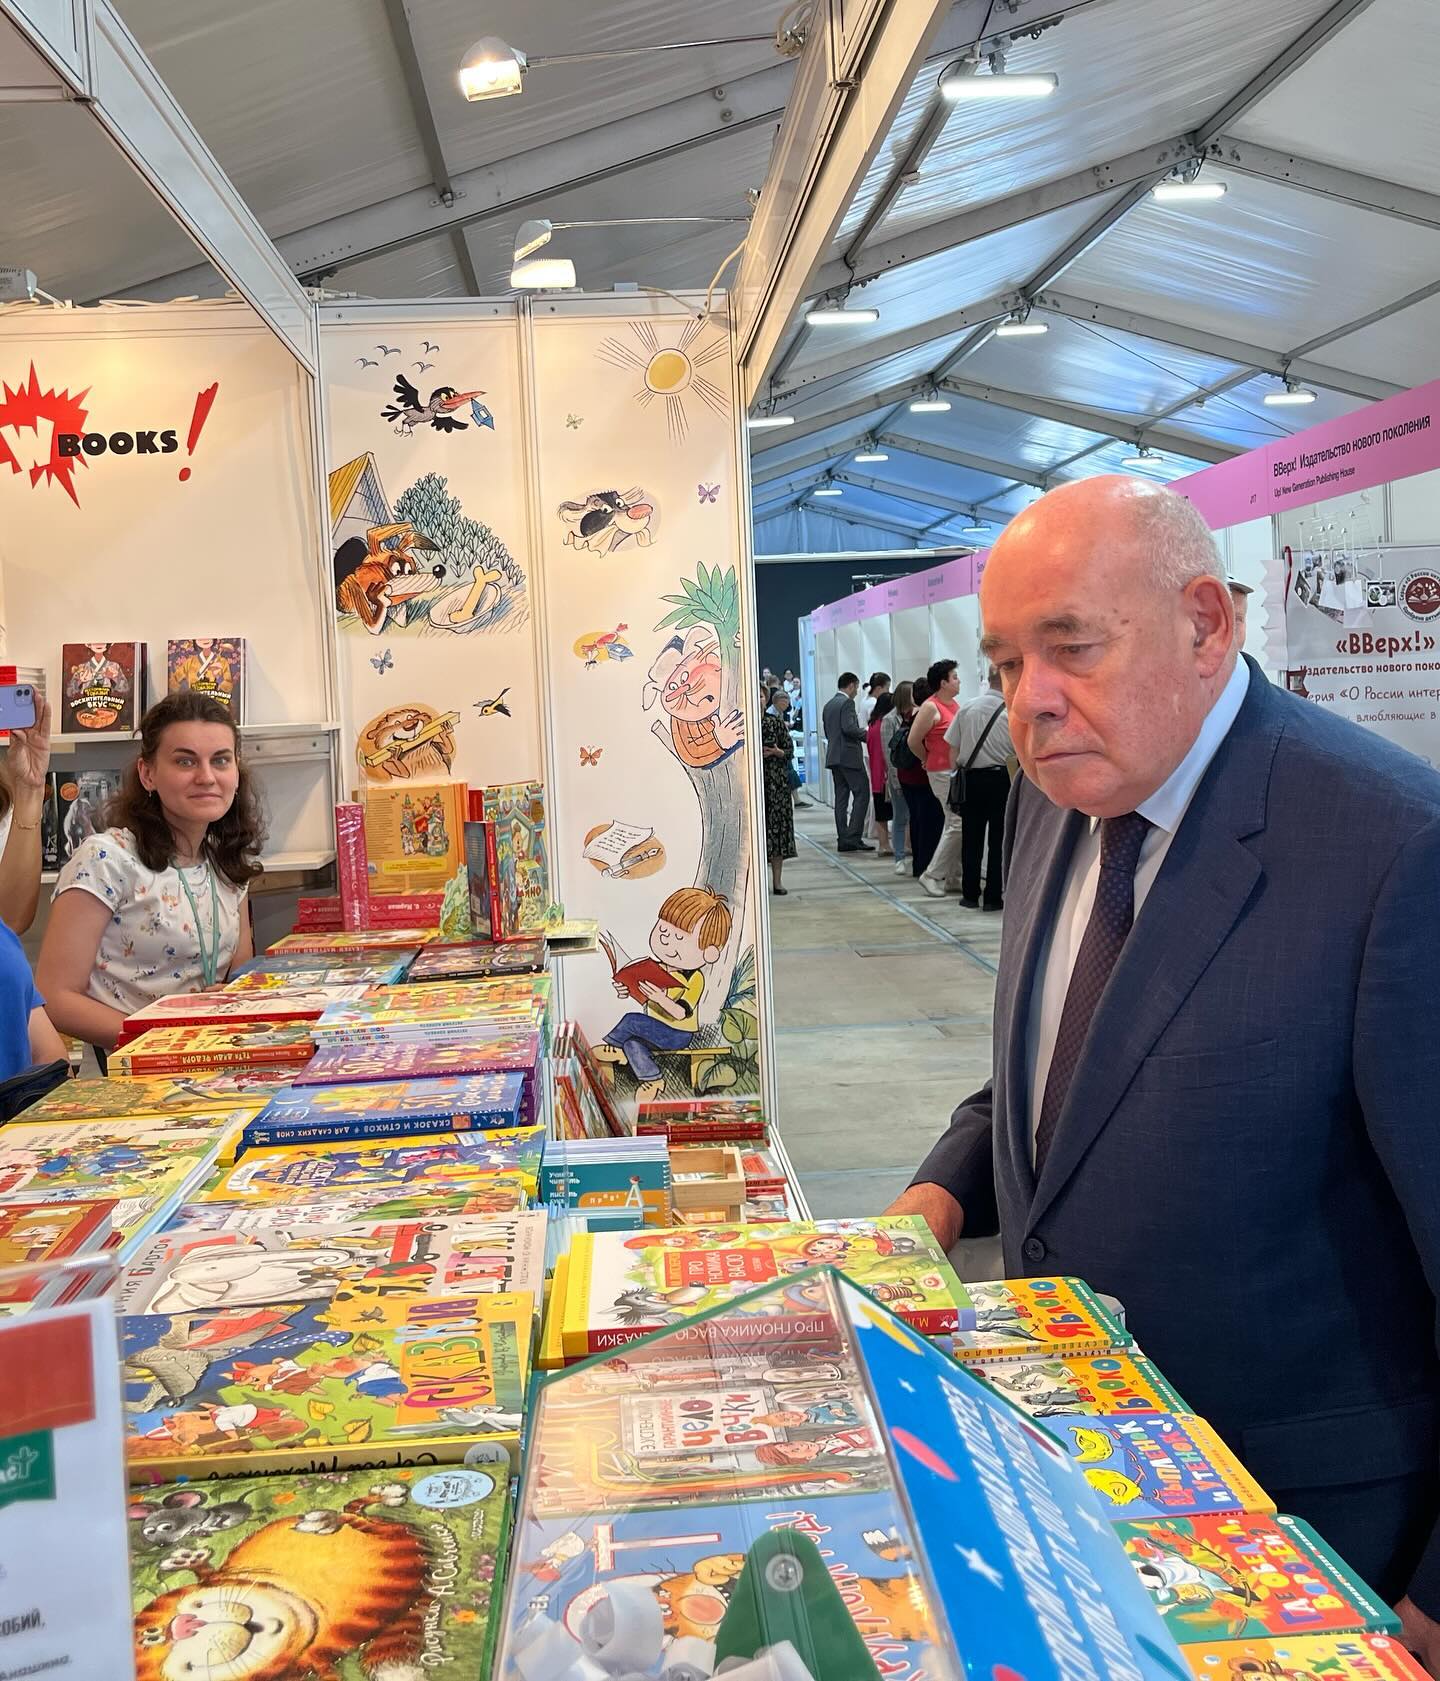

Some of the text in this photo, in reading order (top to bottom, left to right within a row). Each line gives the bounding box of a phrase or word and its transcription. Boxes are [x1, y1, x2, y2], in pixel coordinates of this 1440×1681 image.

[58, 430, 178, 457] BOOKS
[1273, 415, 1431, 477] ВВерх! Издательство нового поколения
[1274, 466, 1356, 498] Up! New Generation Publishing House
[1336, 630, 1435, 658] «ВВерх!»
[1376, 662, 1412, 673] нового
[70, 695, 125, 708] ВОСХИТИТЕЛЬНЫЙ
[1308, 691, 1335, 705] ерия
[1340, 686, 1360, 701] «О
[1365, 685, 1404, 700] России
[298, 1128, 332, 1137] СЛАДКИХ
[334, 1126, 350, 1135] ДЛЯ
[363, 1122, 401, 1133] СТИХОВ
[403, 1122, 411, 1130] И
[413, 1118, 451, 1130] СКАЗОК
[276, 1130, 295, 1139] СНОВ
[688, 1260, 705, 1275] ПРО
[707, 1251, 726, 1283] ГНОМИКА
[726, 1254, 746, 1278] ВАСЮ
[1029, 1281, 1096, 1338] ЯБЛОКО
[674, 1326, 717, 1342] ВАСЮ
[720, 1321, 791, 1339] ГНОМИКА
[792, 1319, 825, 1334] ПРО
[393, 1298, 492, 1410] СКАЗКИ
[1213, 1491, 1232, 1502] И
[1216, 1519, 1290, 1588] ОБЕДАЛ,
[1248, 1528, 1344, 1609] ВОРОБЕЙ?
[1274, 1592, 1323, 1624] ГДЕ
[420, 1600, 455, 1666] Рисунки
